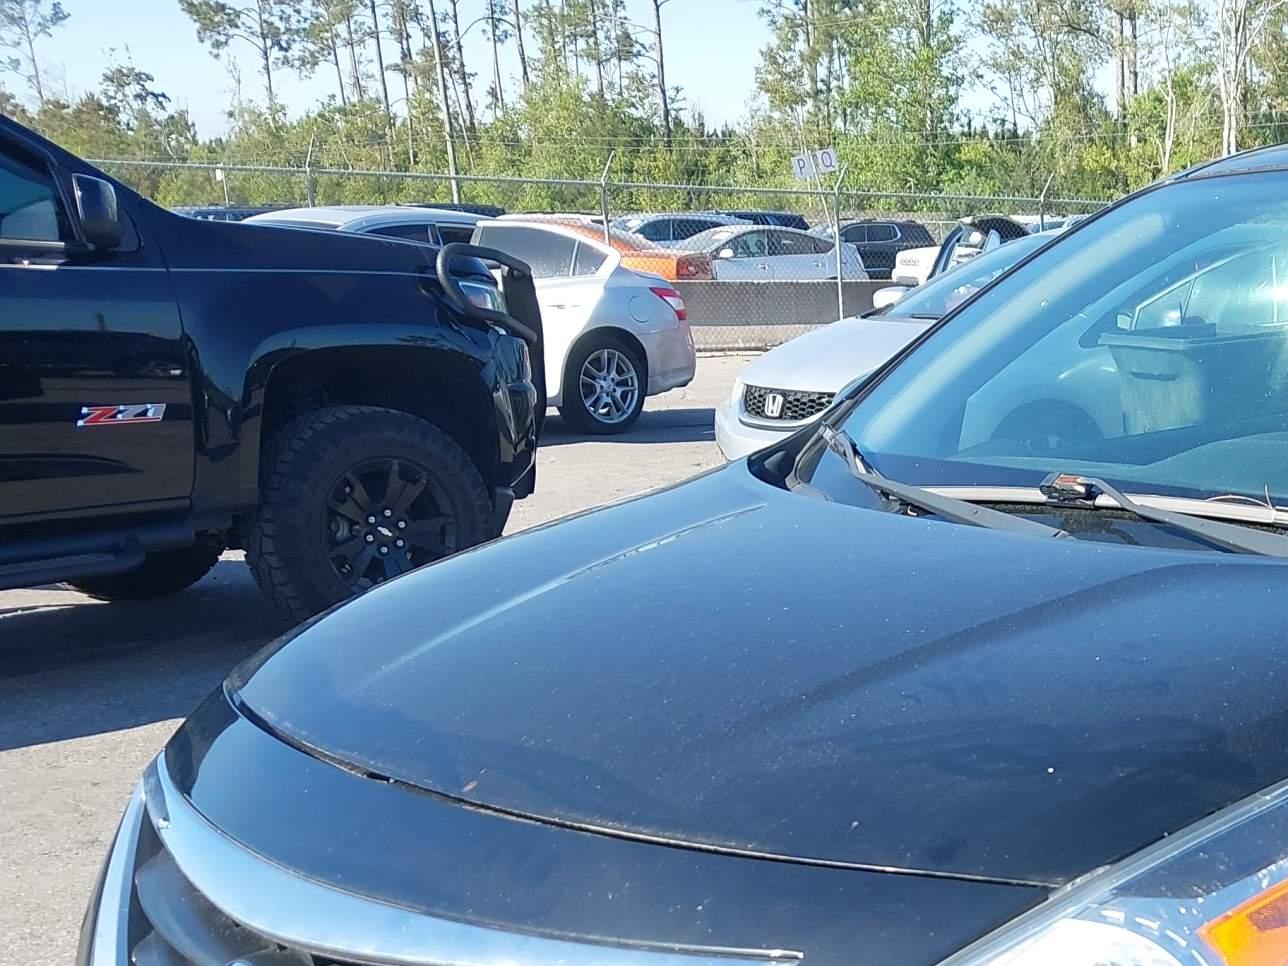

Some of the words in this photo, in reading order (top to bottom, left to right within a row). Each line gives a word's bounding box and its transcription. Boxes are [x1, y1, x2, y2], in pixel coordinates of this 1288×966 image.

[797, 158, 806, 176] P
[821, 151, 836, 169] Q
[77, 403, 167, 426] Z71
